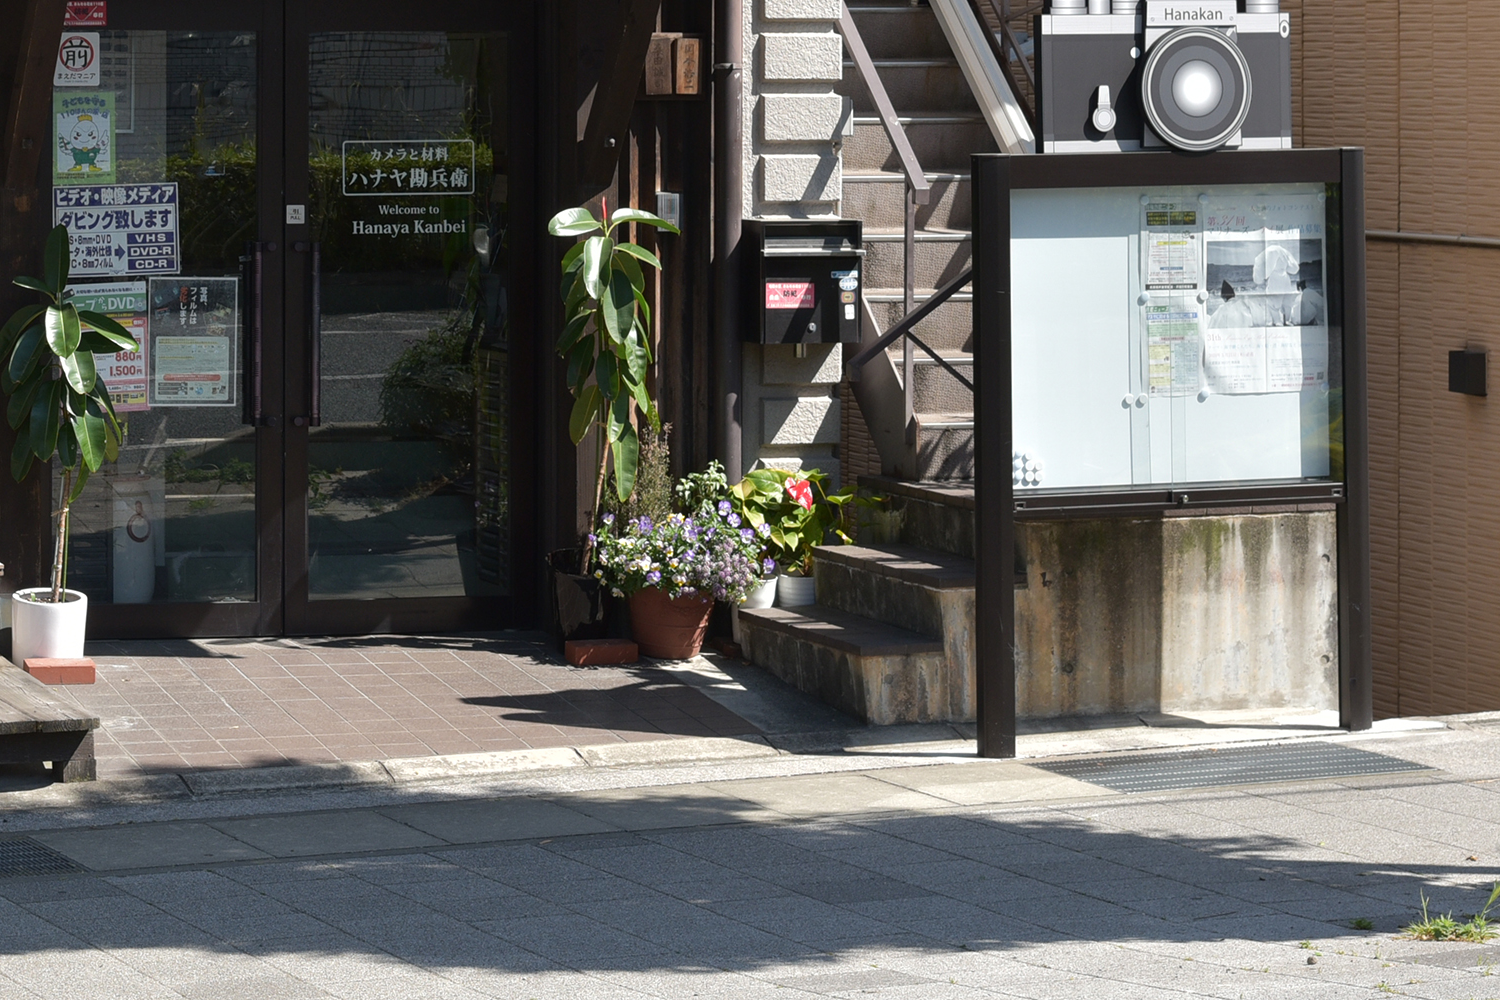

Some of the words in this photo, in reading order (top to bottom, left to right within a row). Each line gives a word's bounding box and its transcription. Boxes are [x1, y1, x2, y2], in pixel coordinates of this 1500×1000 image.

[1164, 7, 1223, 21] Hanakan
[62, 39, 90, 67] 前
[370, 147, 449, 162] カメラと材料
[349, 167, 469, 188] ハナヤ勘兵衛
[56, 186, 174, 206] ビデオ・映像メディア
[378, 204, 426, 215] Welcome
[429, 205, 440, 215] to
[59, 208, 172, 230] ダビング致します
[352, 220, 410, 238] Hanaya
[414, 220, 466, 234] Kanbei
[135, 233, 166, 243] VHS
[130, 247, 172, 256] DVD-R
[135, 259, 168, 269] CD-R
[189, 287, 197, 325] フィルムは
